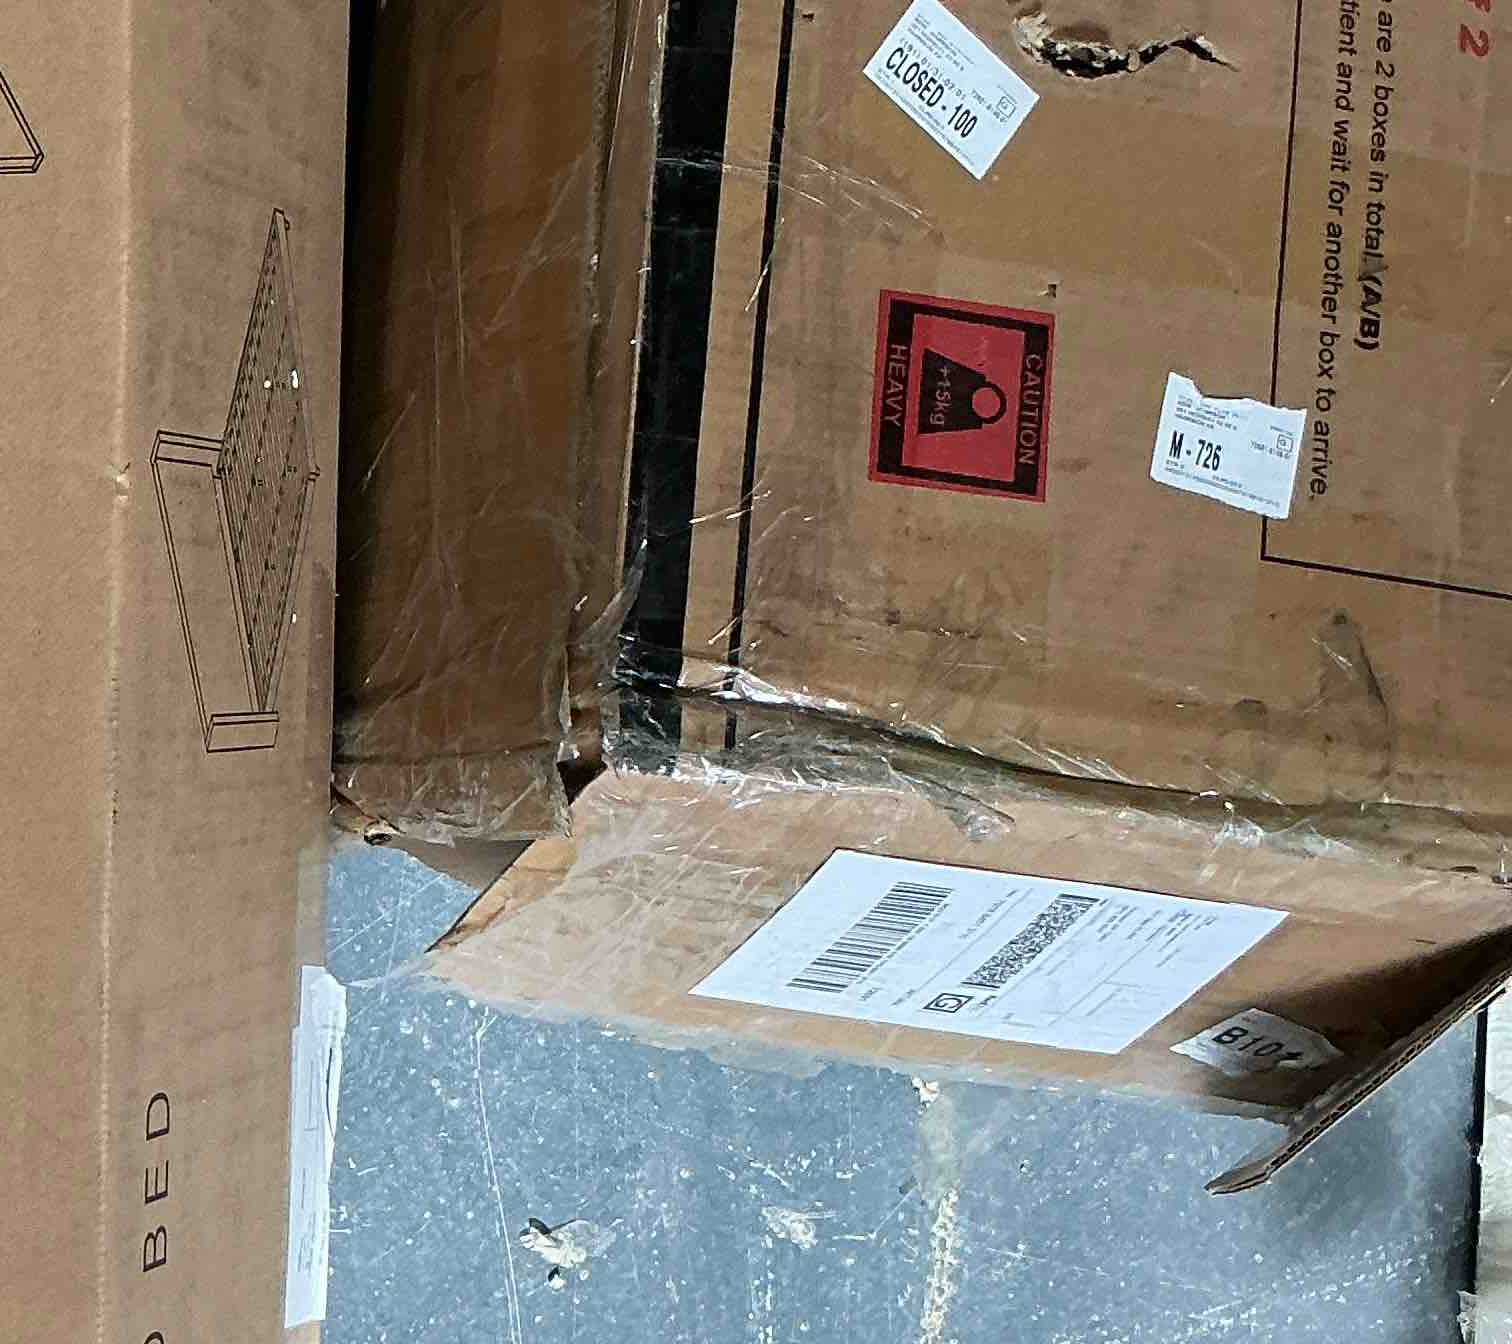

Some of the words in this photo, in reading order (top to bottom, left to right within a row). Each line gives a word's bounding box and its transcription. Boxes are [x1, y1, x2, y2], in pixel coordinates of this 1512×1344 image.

[1375, 10, 1393, 54] are
[1459, 23, 1490, 58] 2
[885, 46, 945, 108] CLOSED
[947, 101, 978, 140] 100
[1335, 61, 1353, 113] and
[1374, 58, 1395, 79] 2
[1330, 117, 1351, 174] wait
[1370, 84, 1394, 163] boxes
[1326, 178, 1350, 217] for
[1366, 171, 1389, 195] in
[1319, 222, 1345, 325] another
[1353, 272, 1384, 353] (A/B)
[1317, 329, 1340, 379] box
[884, 343, 909, 427] HEAVY
[929, 366, 952, 427] +15kg
[1019, 354, 1044, 466] CAUTION
[1314, 386, 1336, 414] to
[1169, 429, 1185, 460] M
[1194, 439, 1223, 472] 726
[1308, 419, 1331, 502] arrive.
[143, 1092, 170, 1273] BED
